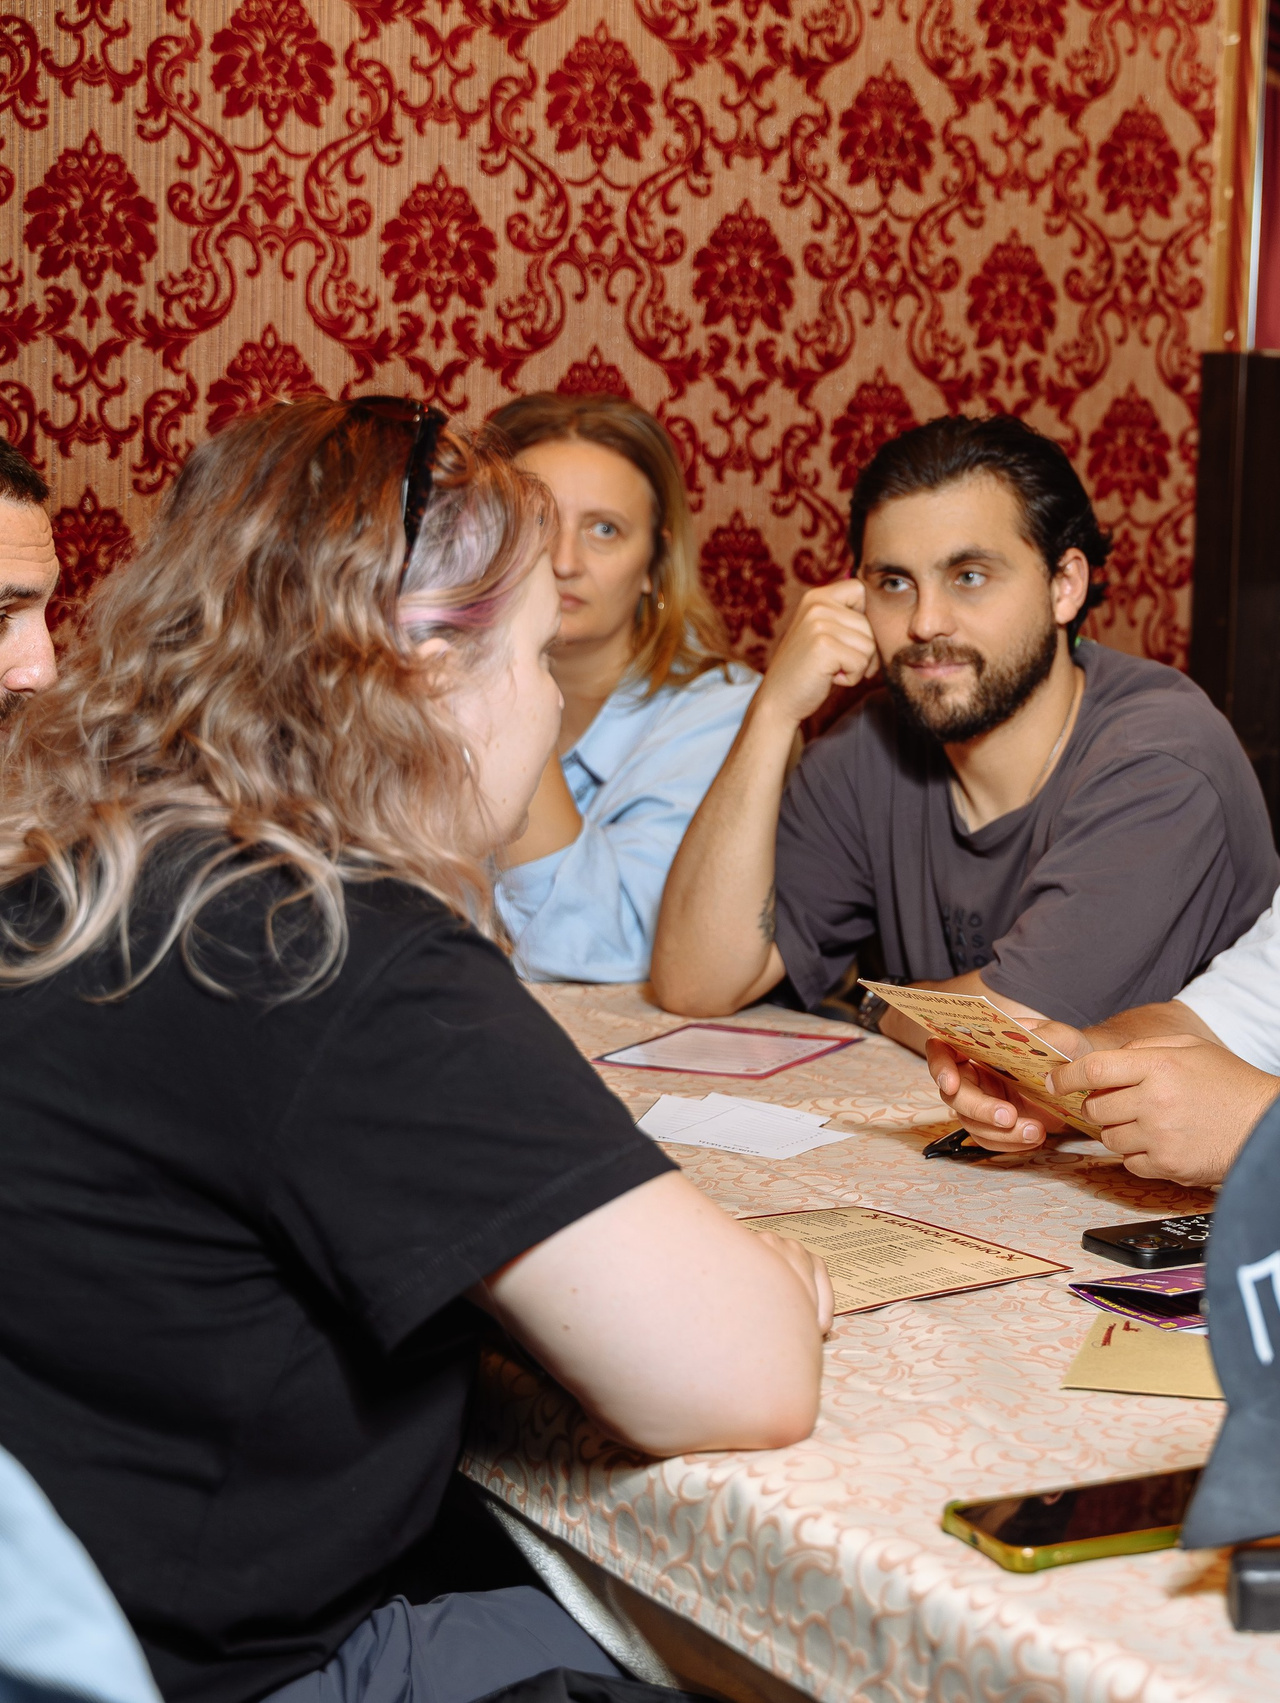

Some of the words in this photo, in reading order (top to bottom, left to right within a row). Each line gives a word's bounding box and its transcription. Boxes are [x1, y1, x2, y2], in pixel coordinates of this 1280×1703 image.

[949, 998, 990, 1010] КАРТА
[883, 1218, 947, 1239] БАРНОЕ
[946, 1236, 1002, 1256] МЕНЮ
